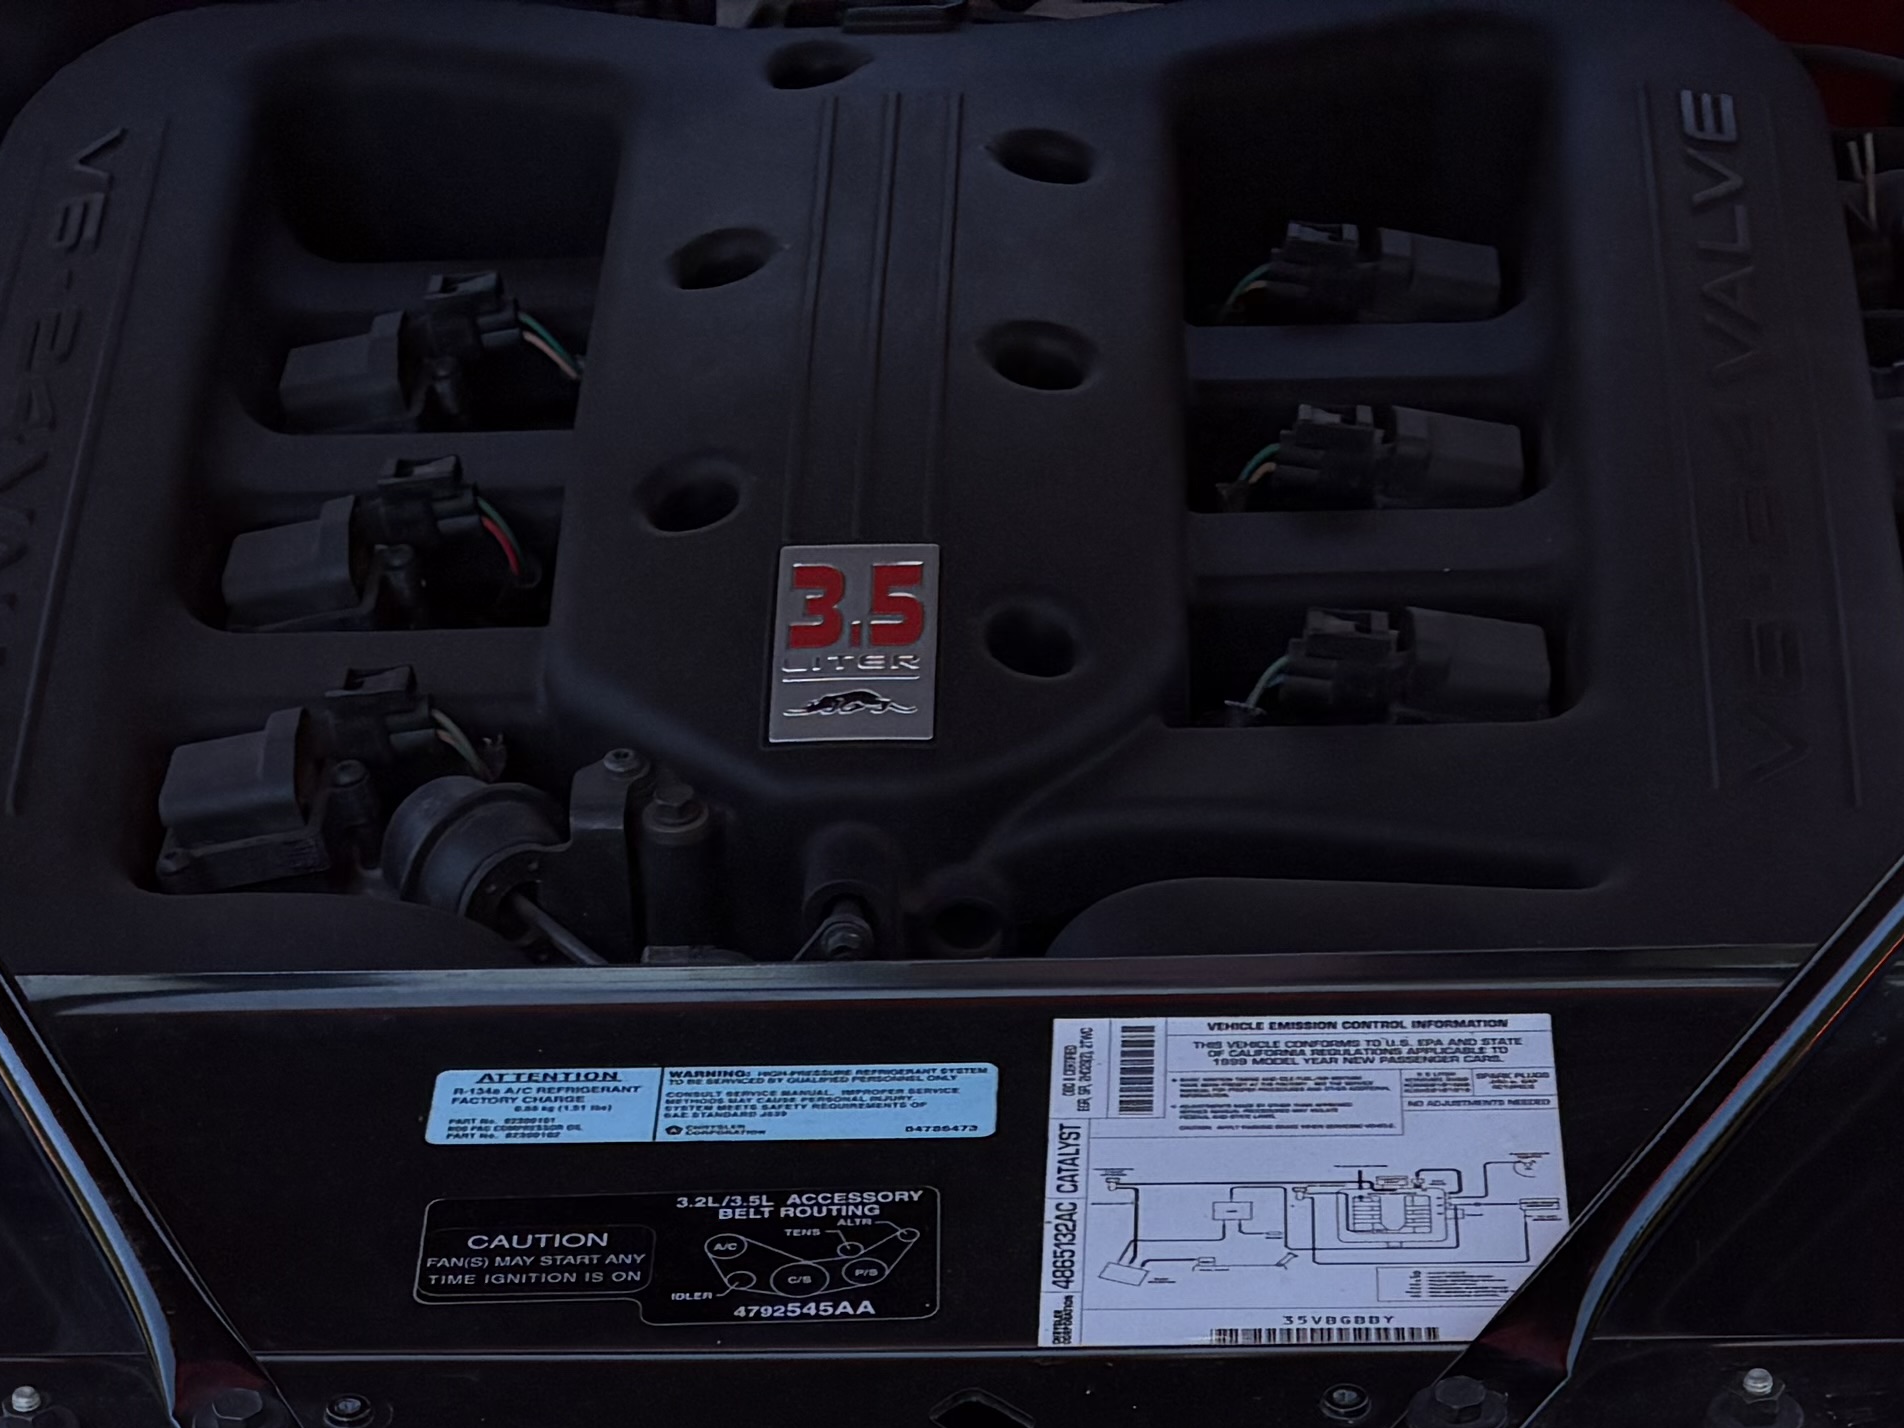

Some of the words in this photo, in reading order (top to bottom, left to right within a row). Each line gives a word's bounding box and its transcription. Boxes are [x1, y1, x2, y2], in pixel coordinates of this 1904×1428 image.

[788, 561, 926, 649] 3.5
[782, 655, 920, 672] LITER
[1207, 1022, 1264, 1031] VEHICLE
[1268, 1021, 1337, 1030] EMISSION
[1341, 1020, 1407, 1029] CONTROL
[1412, 1019, 1508, 1028] INFORMATION
[1194, 1041, 1223, 1049] THIS
[1284, 1040, 1360, 1048] CONFORMS
[1364, 1039, 1381, 1047] TO
[1229, 1049, 1306, 1057] CALIFORNIA
[1310, 1048, 1403, 1056] REGULATIONS
[1343, 1056, 1375, 1064] NEW
[477, 1072, 618, 1083] ATTENTION
[669, 1070, 751, 1078] WARNING:
[536, 1086, 641, 1094] REFRIGERANT
[1056, 1123, 1081, 1194] CATALYST
[677, 1195, 774, 1208] 3.2L/3.5L
[787, 1191, 923, 1205] ACCESSORY
[719, 1207, 773, 1219] BELT
[780, 1205, 881, 1217] ROUTING
[837, 1218, 872, 1226] ALTR
[467, 1233, 608, 1249] CAUTION
[1052, 1203, 1078, 1289] 4865132AC
[427, 1257, 489, 1268] FAN(S)
[495, 1256, 535, 1267] MAY
[540, 1255, 602, 1265] START
[605, 1254, 645, 1264] ANY
[428, 1275, 476, 1284] TIME
[485, 1273, 576, 1283] IGNITION
[585, 1272, 604, 1282] IS
[612, 1272, 641, 1281] ON
[671, 1292, 712, 1300] IDLER
[734, 1301, 876, 1318] 4792545AA
